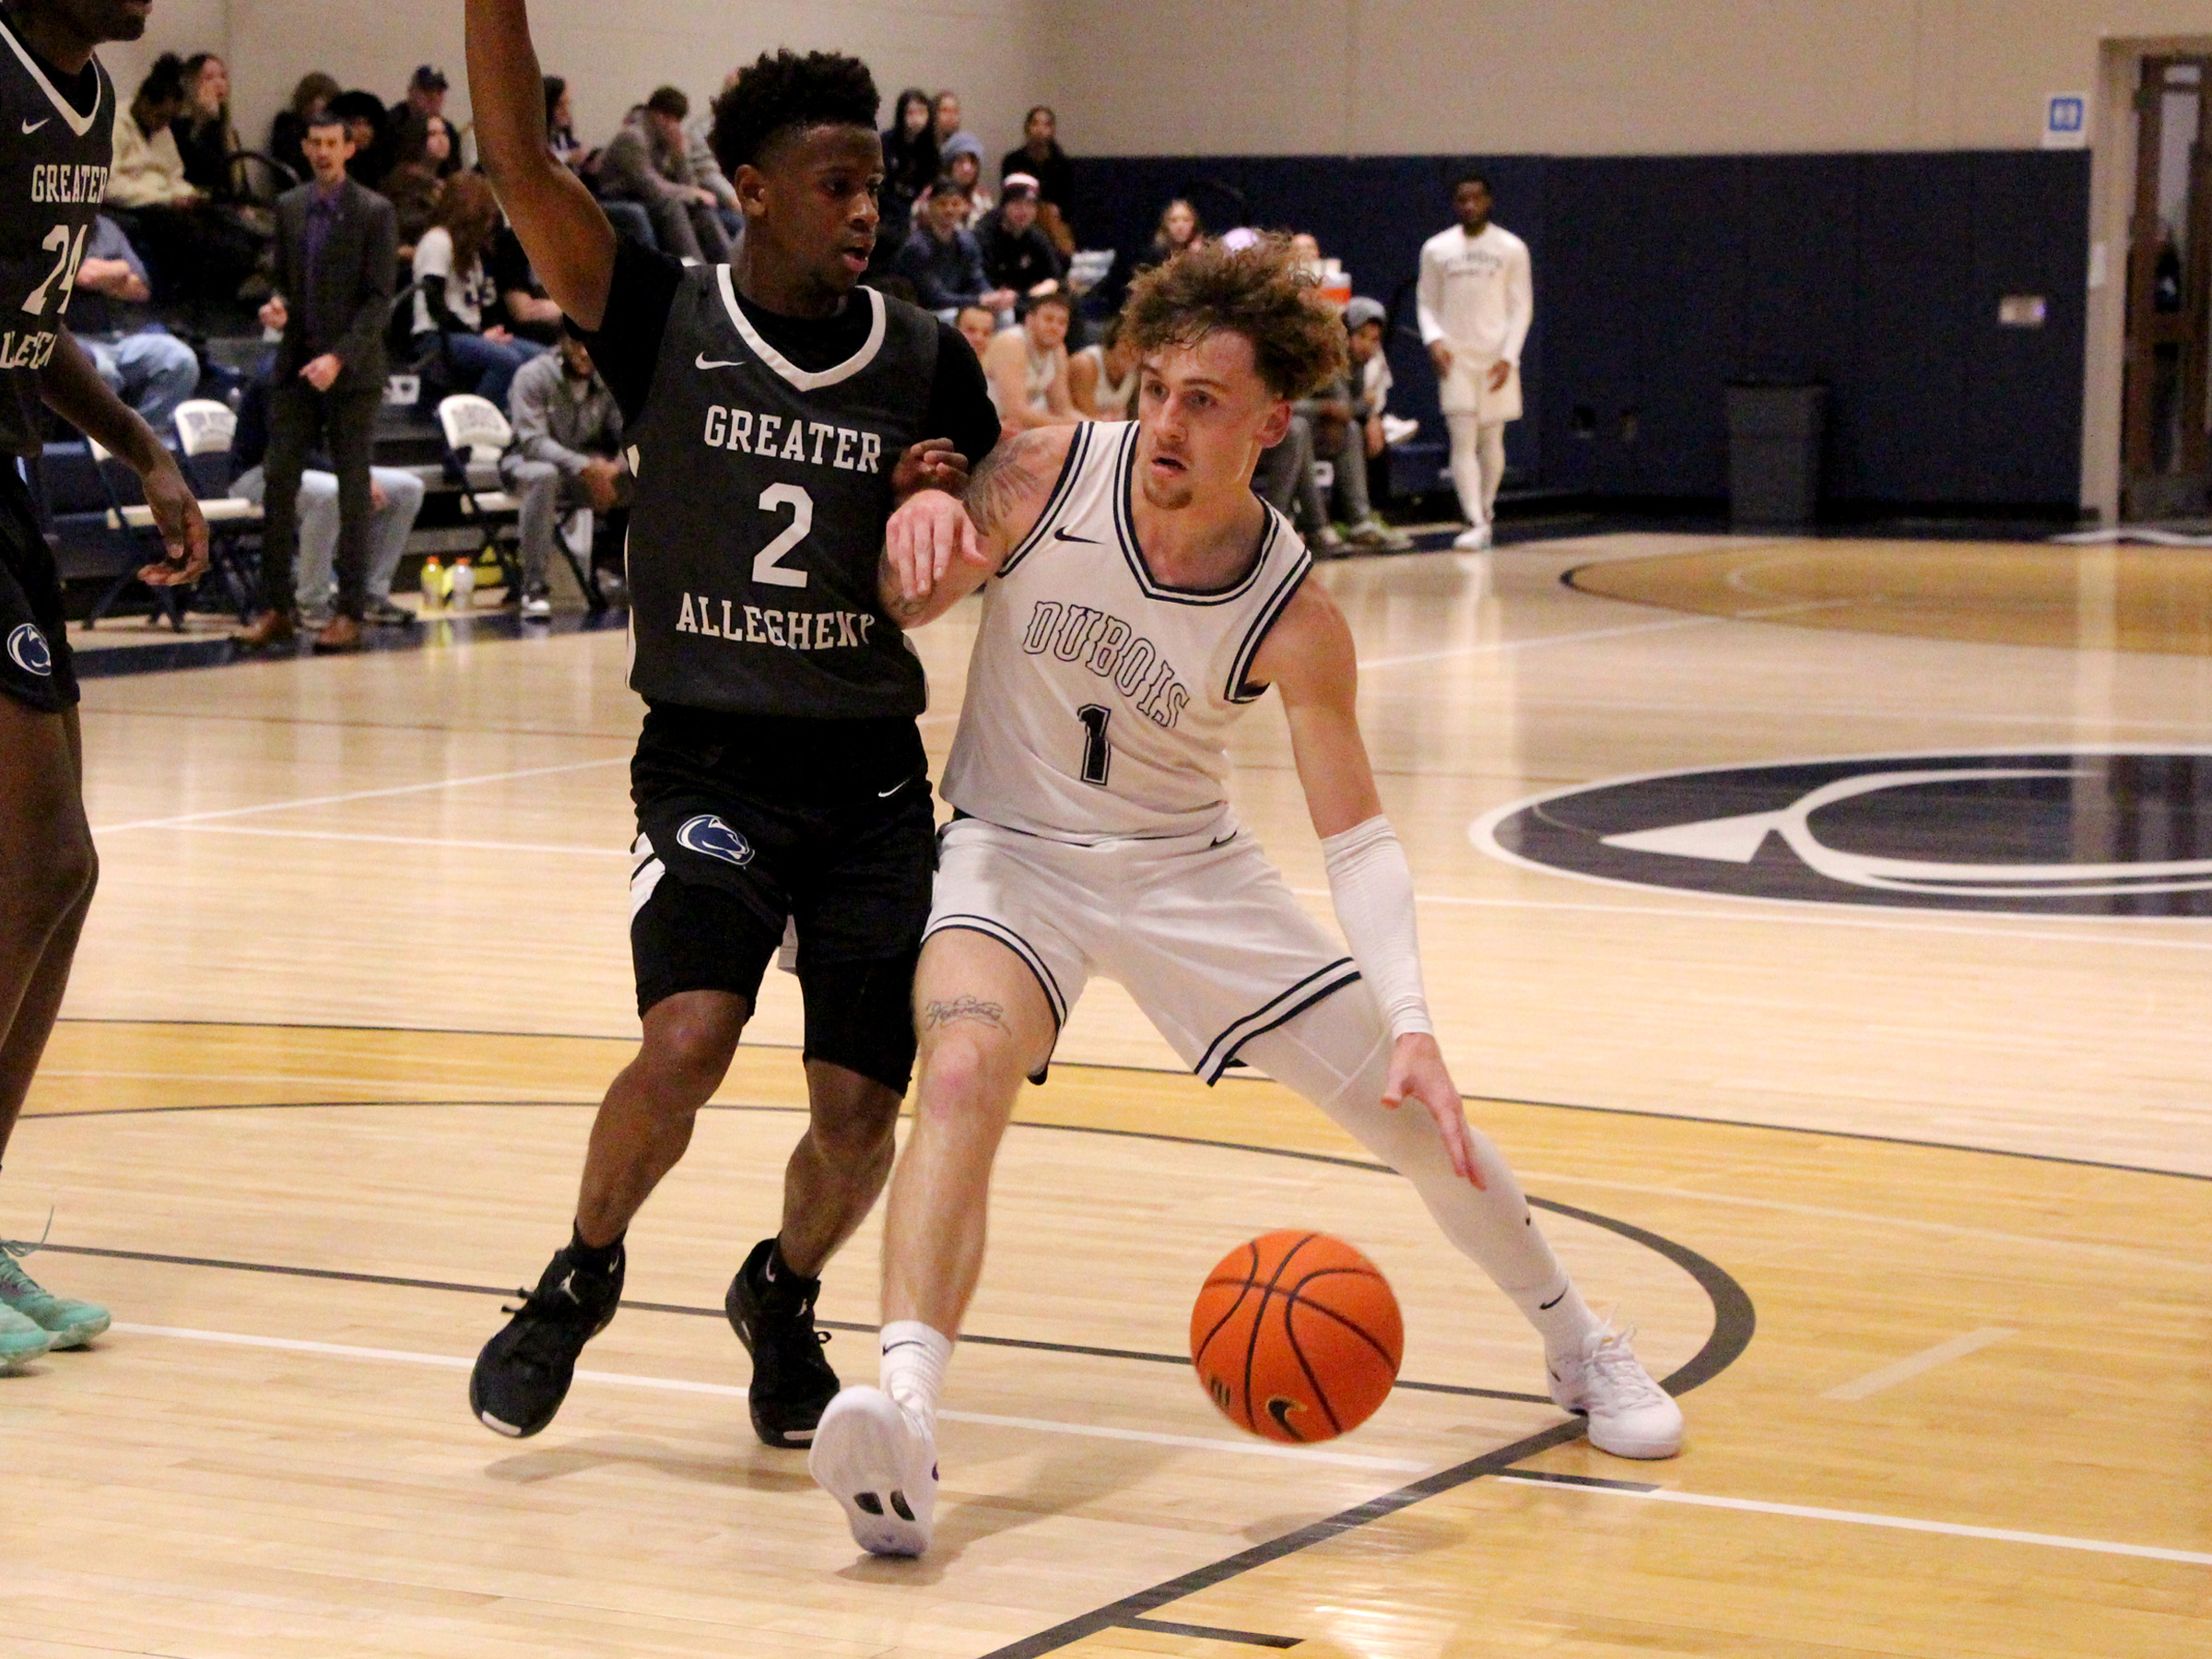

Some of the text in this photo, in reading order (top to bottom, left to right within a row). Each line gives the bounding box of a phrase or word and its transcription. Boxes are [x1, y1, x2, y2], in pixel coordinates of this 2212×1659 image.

[31, 164, 108, 204] GREATER
[21, 224, 88, 315] 24
[704, 405, 881, 474] GREATER
[752, 482, 813, 588] 2
[1023, 601, 1190, 728] DUBOIS
[1077, 703, 1112, 786] 1
